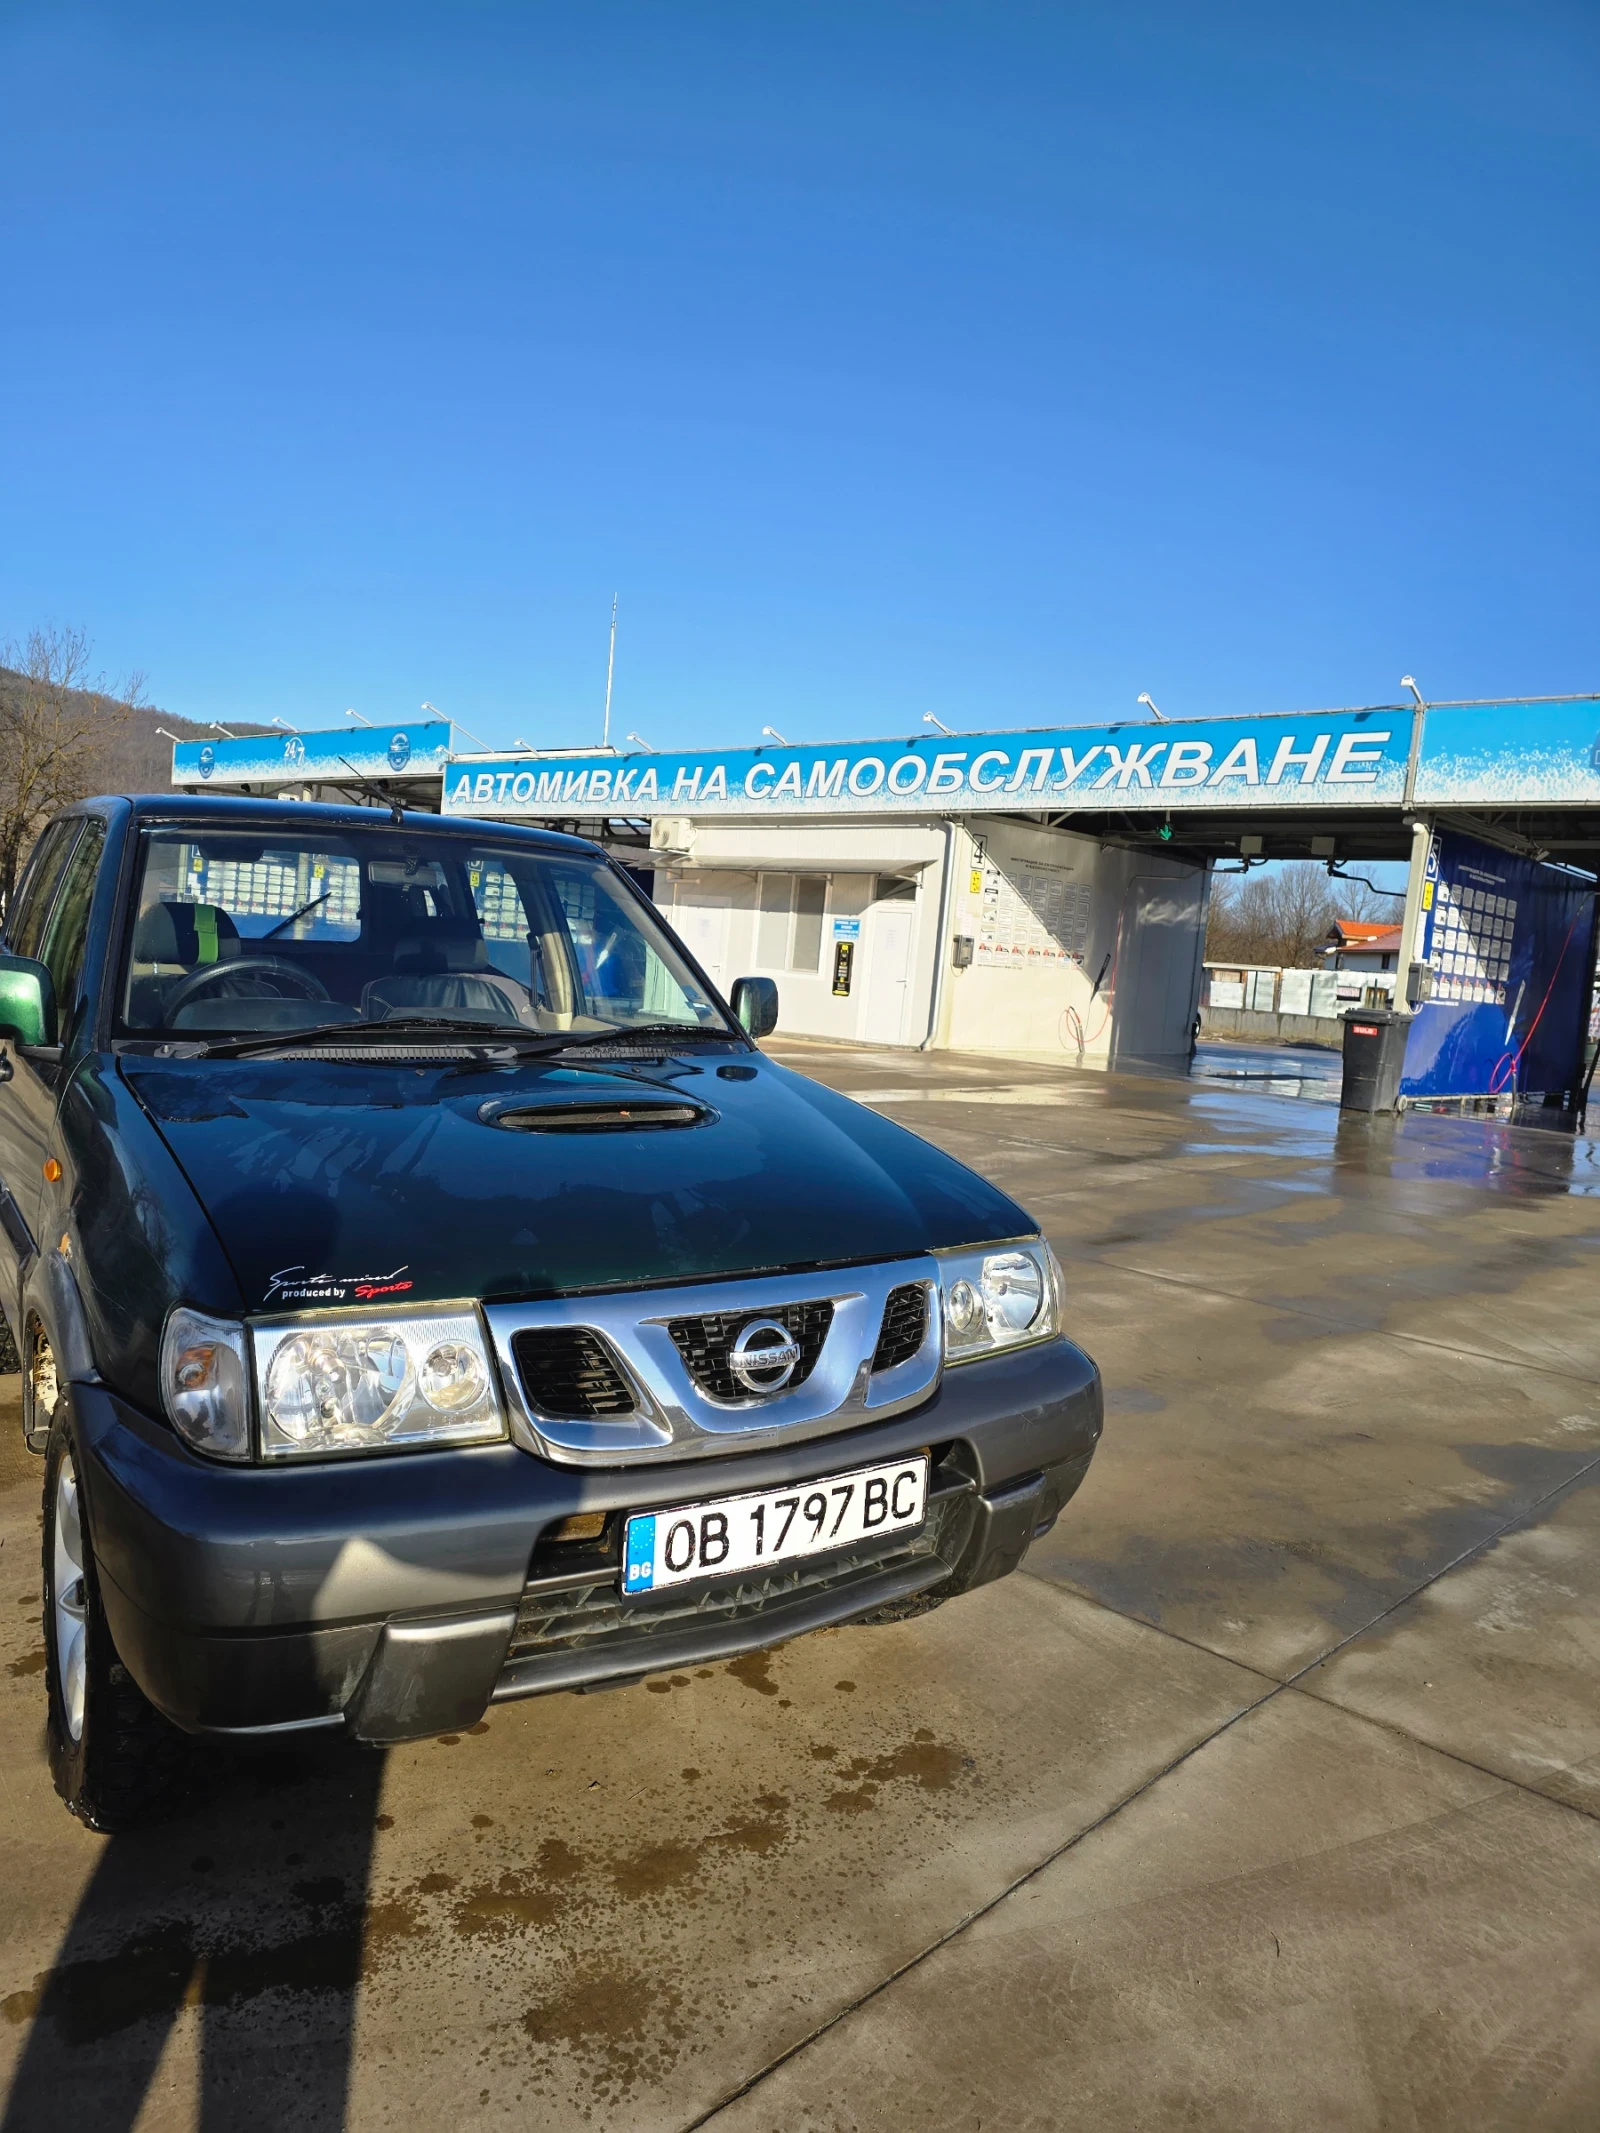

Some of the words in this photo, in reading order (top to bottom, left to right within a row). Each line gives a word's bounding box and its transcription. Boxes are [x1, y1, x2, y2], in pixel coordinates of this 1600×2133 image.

[451, 767, 658, 803] АВТОМИВКА
[671, 765, 727, 801] НА
[744, 731, 1392, 799] САМООБСЛУЖВАНЕ
[973, 840, 984, 864] 4
[282, 1287, 331, 1299] produced
[333, 1287, 346, 1298] by
[355, 1281, 413, 1299] Sports
[740, 1346, 797, 1367] NISSAN
[665, 1511, 730, 1573] OB
[750, 1484, 855, 1556] 1797
[863, 1470, 917, 1529] BC
[629, 1561, 652, 1580] BG
